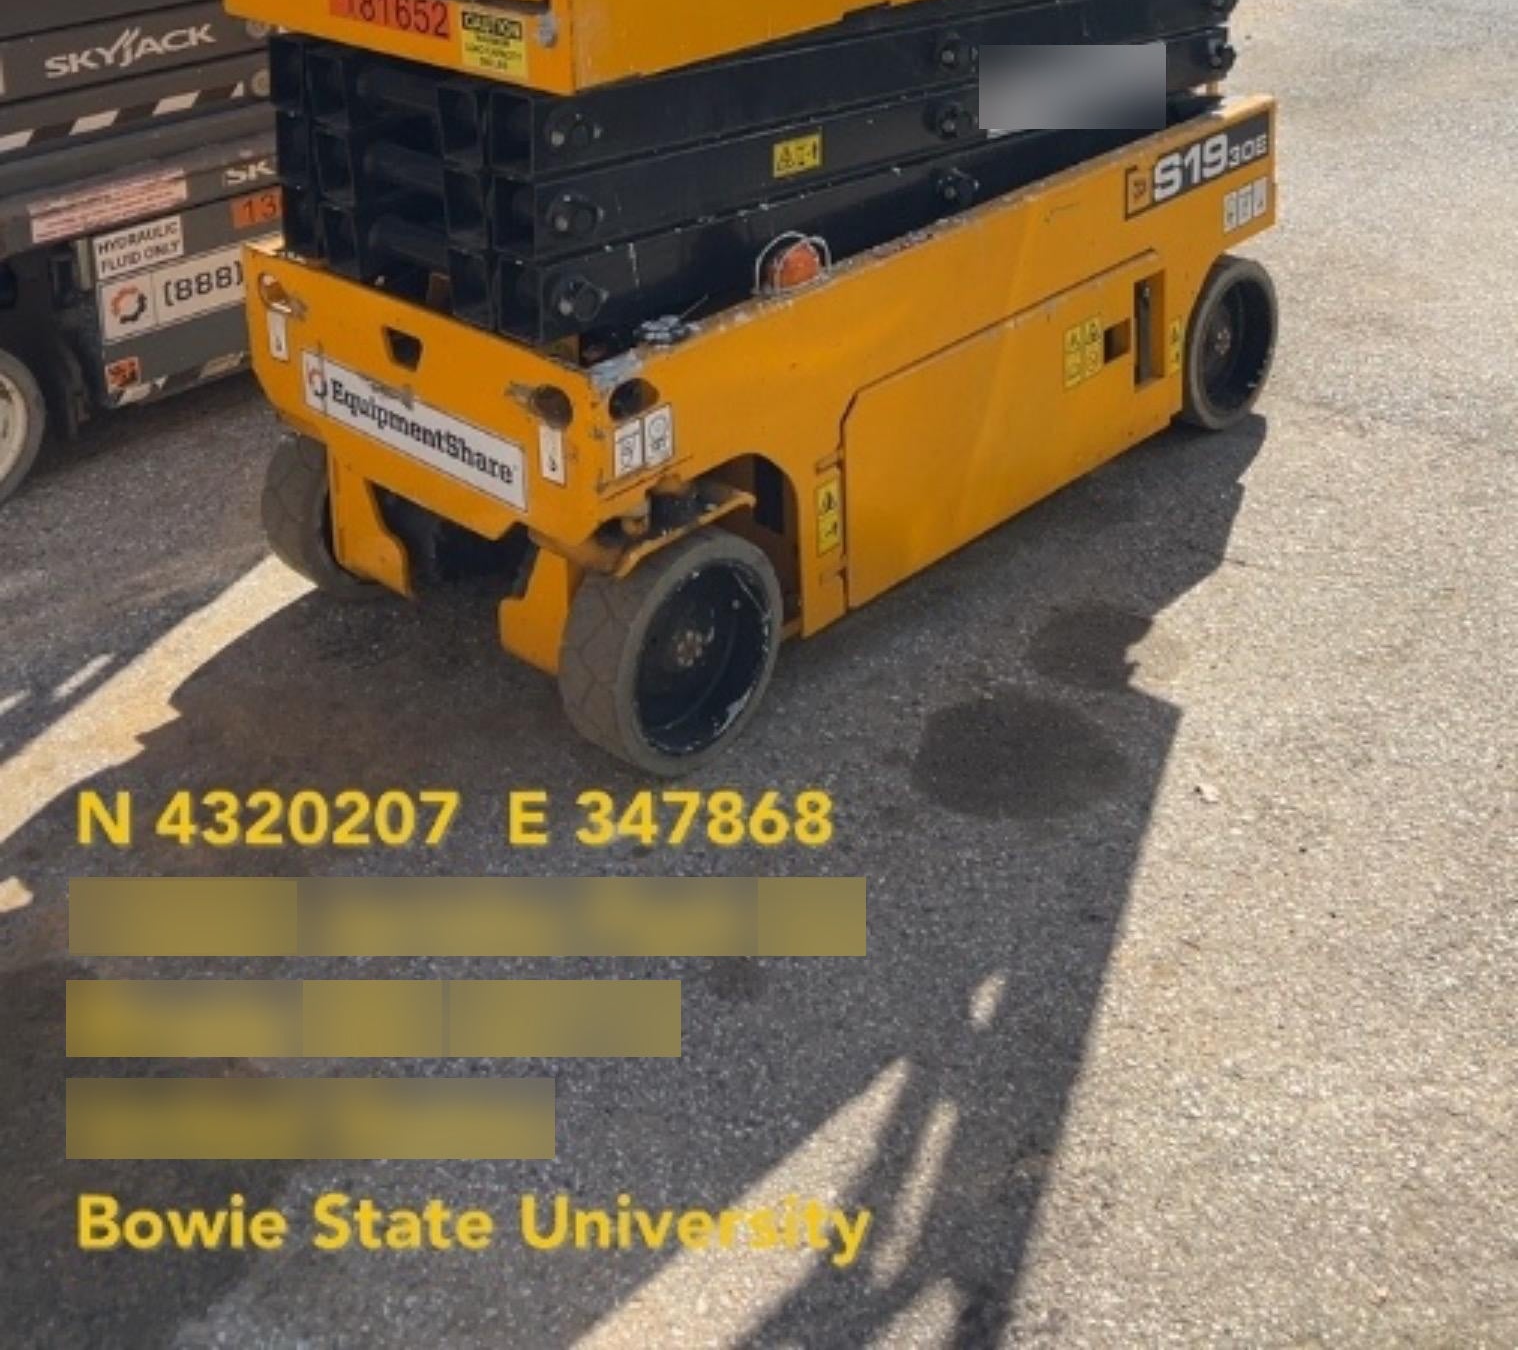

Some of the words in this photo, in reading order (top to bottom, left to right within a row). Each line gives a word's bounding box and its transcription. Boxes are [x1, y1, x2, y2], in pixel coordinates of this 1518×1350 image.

[44, 23, 217, 79] SKYJACK
[97, 222, 179, 255] HYDRAULIC
[101, 251, 143, 274] FLUID
[143, 240, 181, 262] ONLY
[330, 378, 514, 484] EquipmentShare
